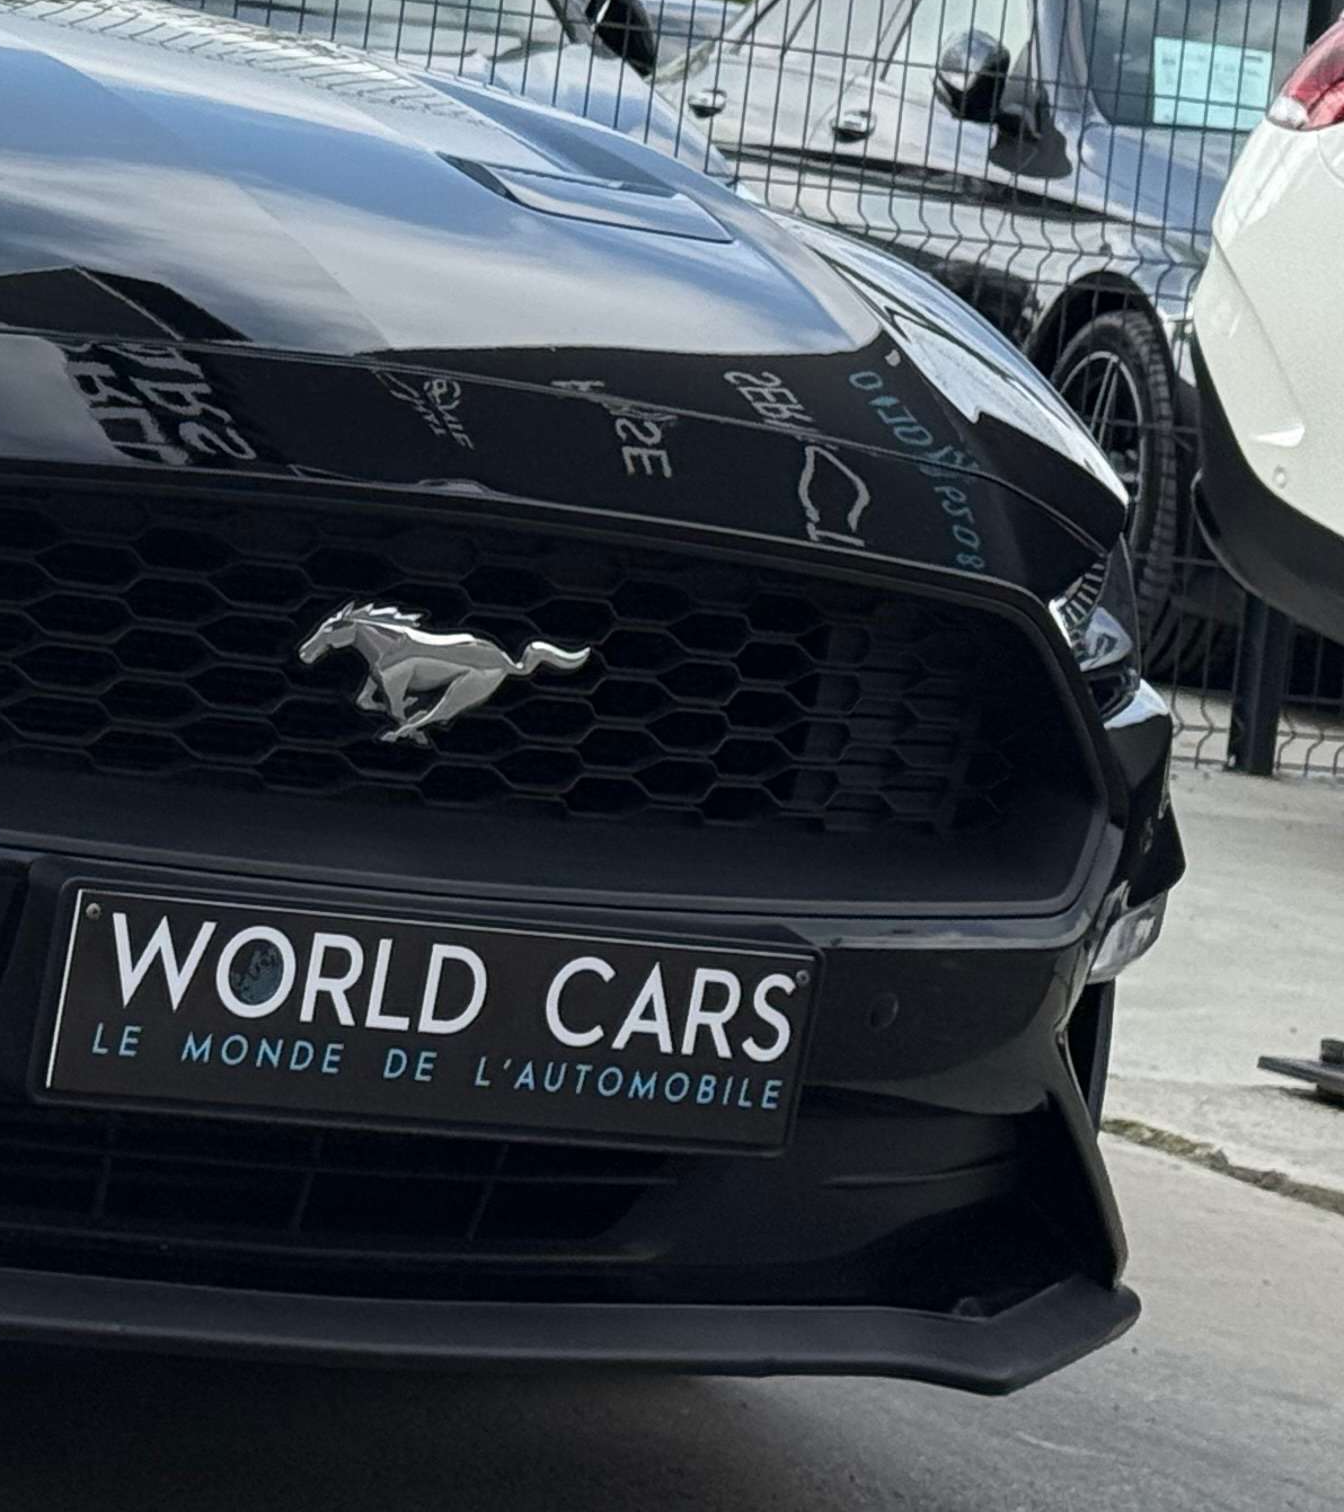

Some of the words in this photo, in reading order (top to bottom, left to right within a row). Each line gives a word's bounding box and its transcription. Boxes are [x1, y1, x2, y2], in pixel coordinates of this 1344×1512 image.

[113, 912, 488, 1034] WORLD
[546, 956, 798, 1063] CARS
[93, 1023, 142, 1056] LE
[181, 1033, 344, 1074] MONDE
[383, 1049, 437, 1082] DE
[474, 1056, 783, 1109] L'AUTOMOBILE
